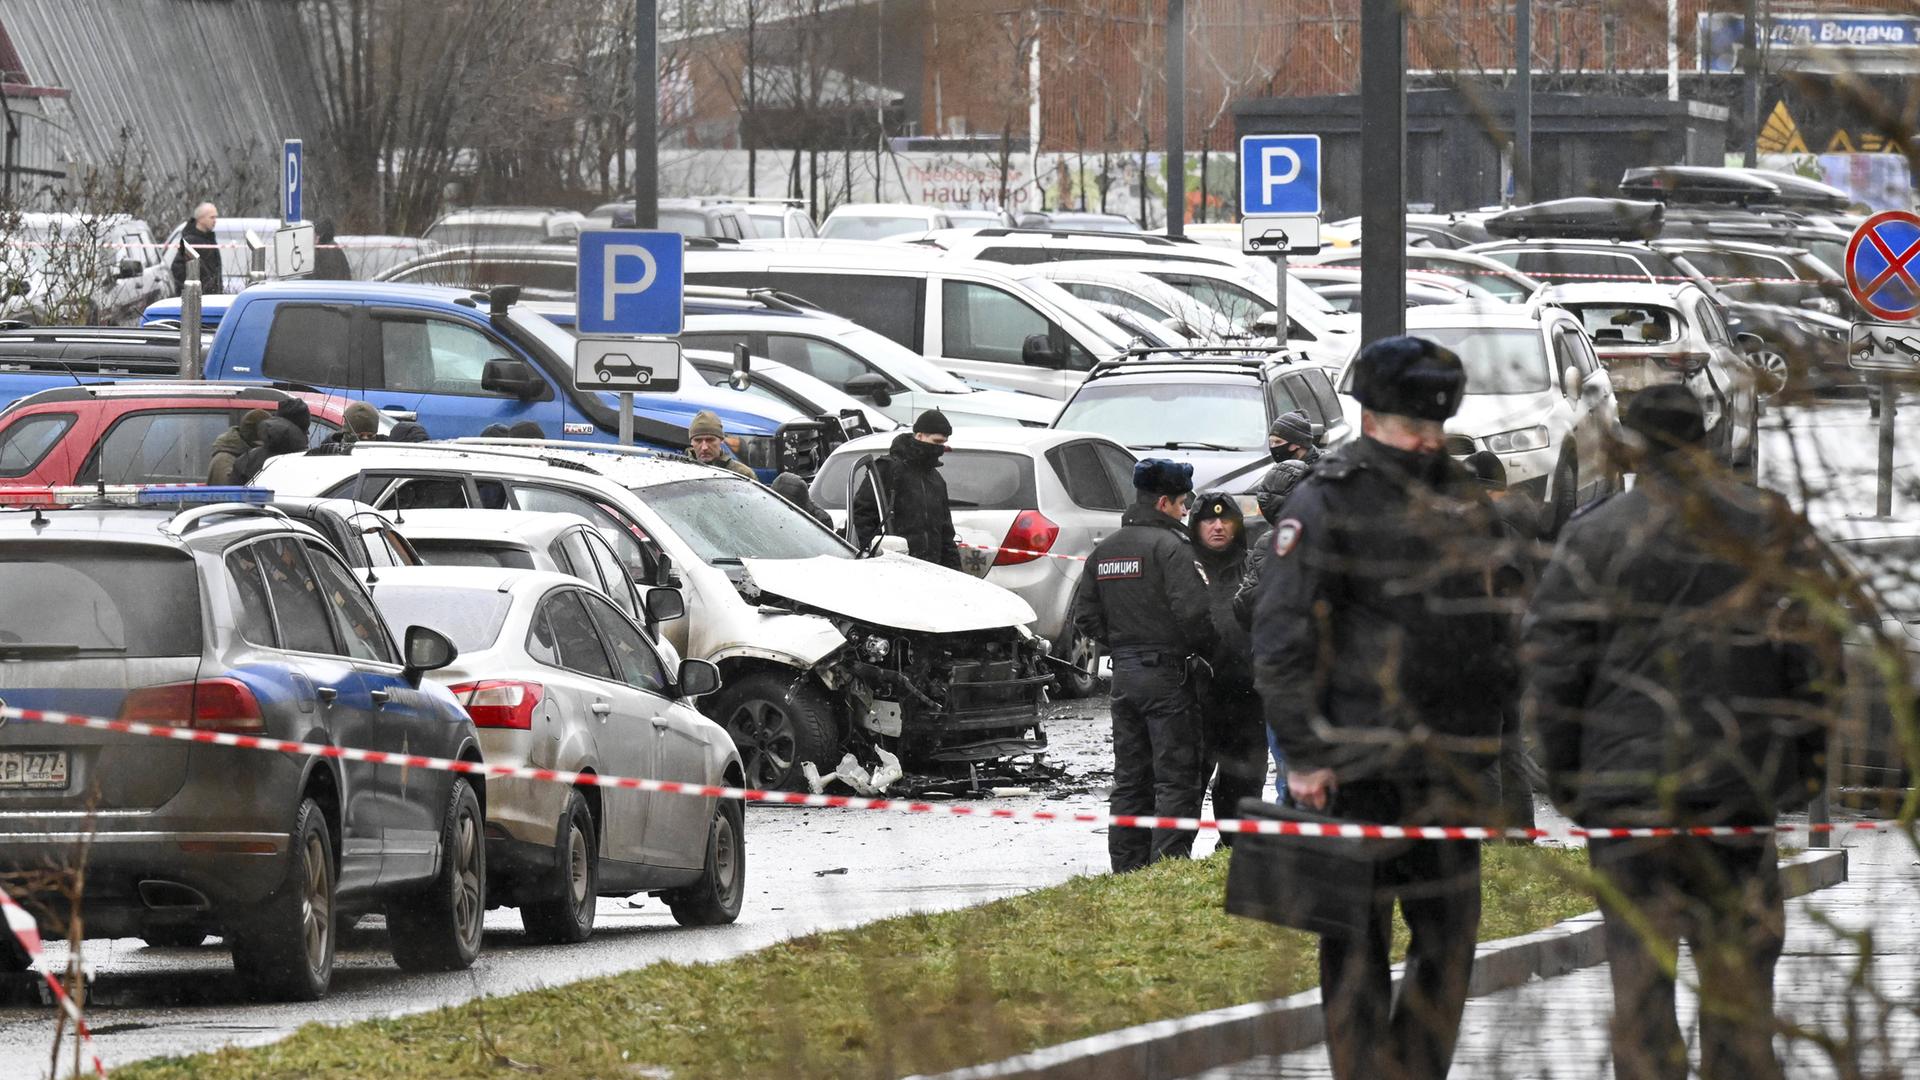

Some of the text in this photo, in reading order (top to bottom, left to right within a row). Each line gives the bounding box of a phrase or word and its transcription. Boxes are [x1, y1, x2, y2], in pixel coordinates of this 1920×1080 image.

[1820, 22, 1904, 44] Выдача
[288, 152, 298, 215] P
[922, 187, 970, 203] наш
[1261, 147, 1301, 206] P
[603, 244, 657, 321] P
[1098, 560, 1139, 576] ПОЛИЦИЯ
